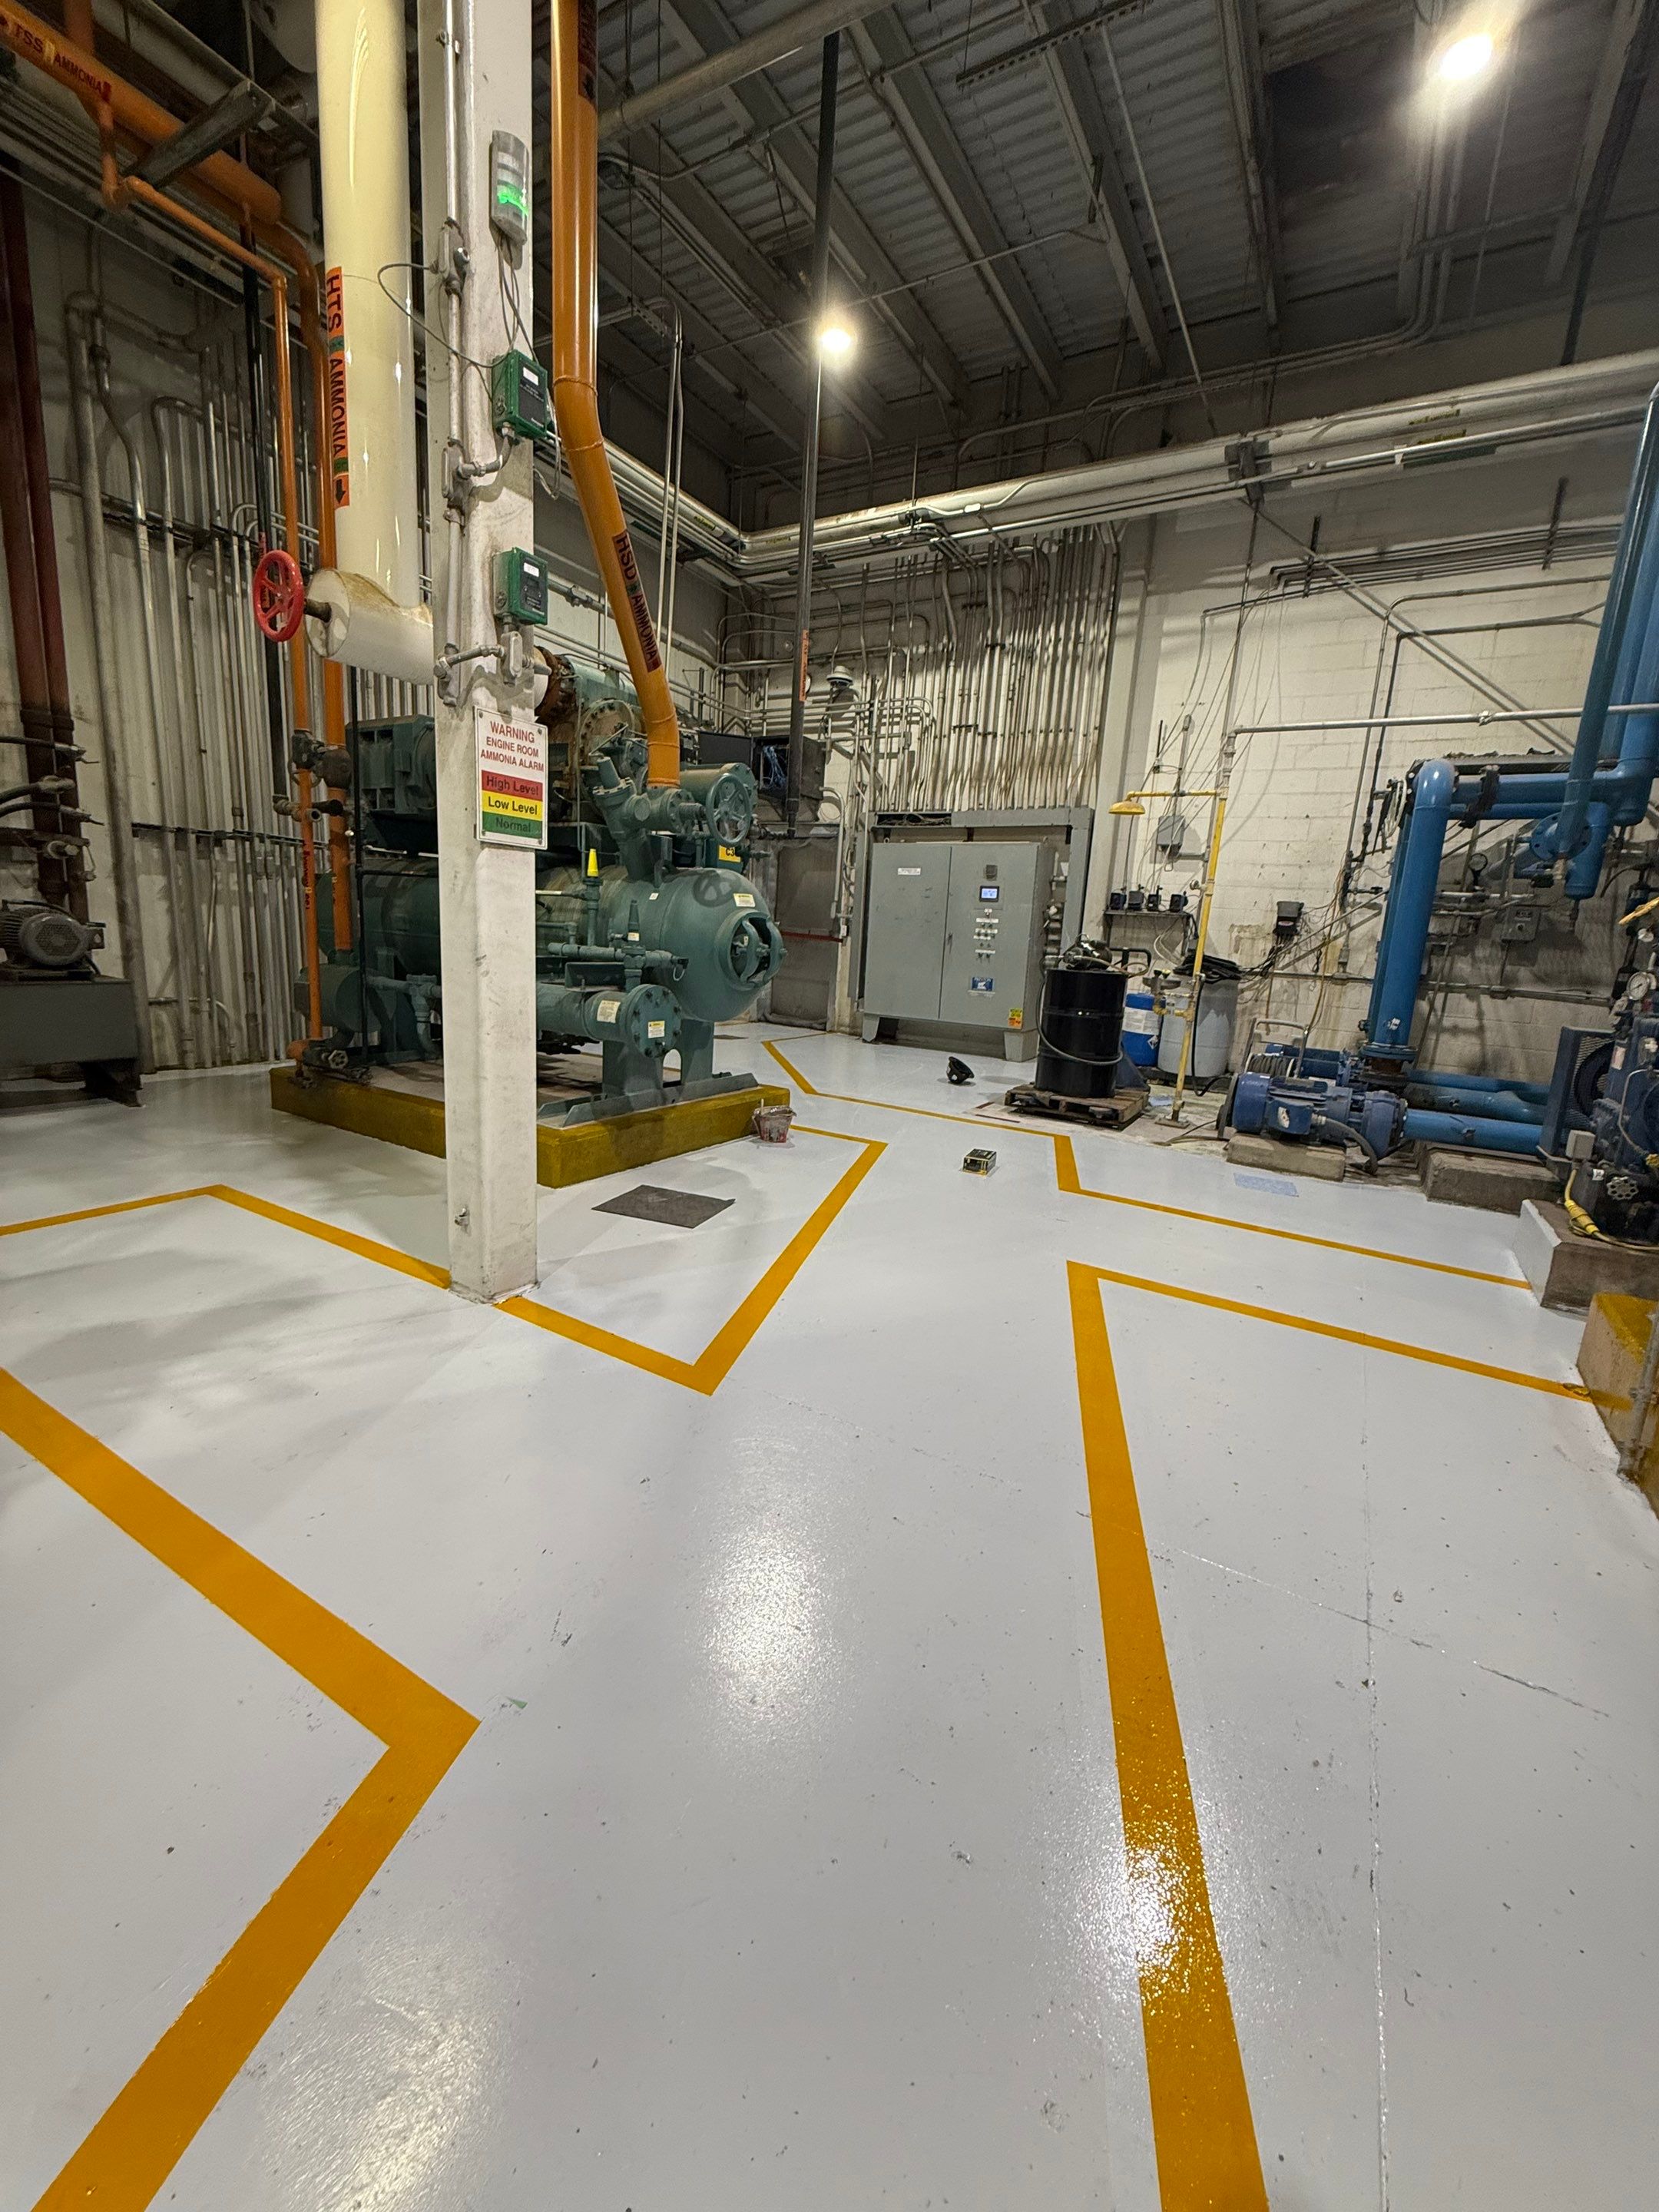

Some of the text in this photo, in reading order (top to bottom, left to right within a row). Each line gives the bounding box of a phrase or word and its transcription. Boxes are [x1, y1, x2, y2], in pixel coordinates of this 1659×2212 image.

[326, 274, 341, 332] HTS
[329, 358, 346, 455] AMMONIA
[616, 535, 658, 661] HSD AMMONIA
[490, 721, 535, 743] WARNING
[486, 737, 539, 758] ENGINE ROOM
[481, 749, 545, 773] AMMONIA ALARM
[486, 776, 538, 796] High Level
[488, 796, 538, 815] Low Level
[495, 817, 531, 833] Normal
